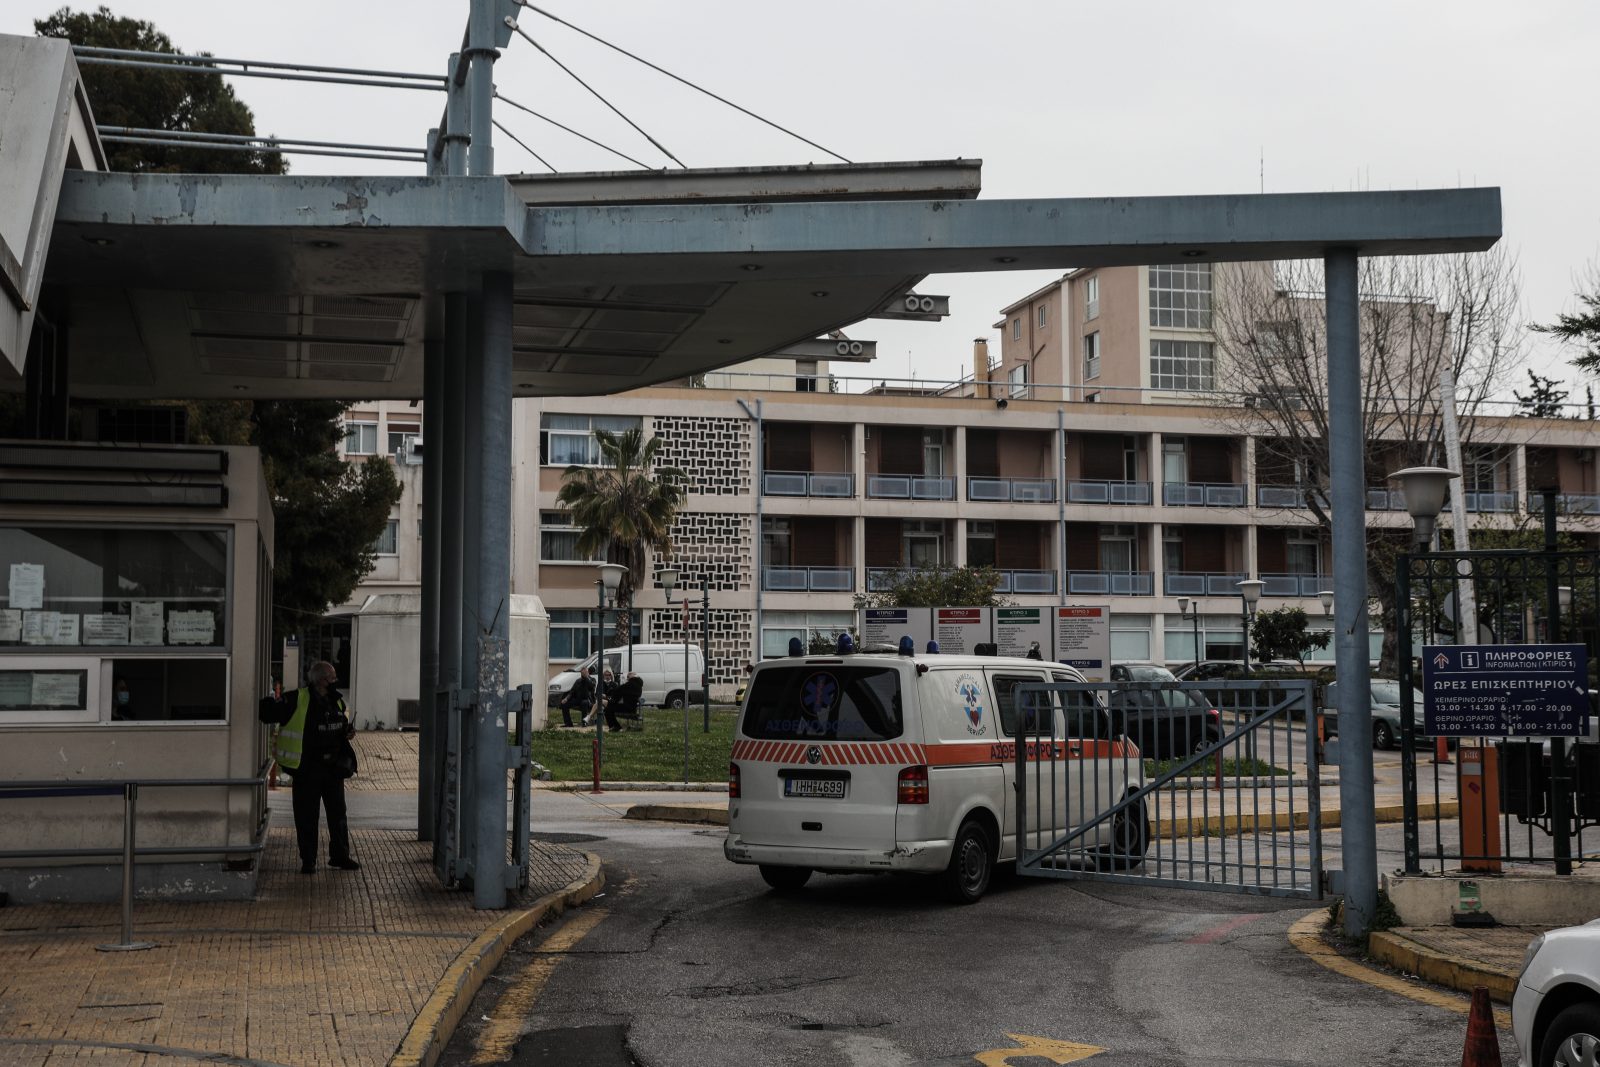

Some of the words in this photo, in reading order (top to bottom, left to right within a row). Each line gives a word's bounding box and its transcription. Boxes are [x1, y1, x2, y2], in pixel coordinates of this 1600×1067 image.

[1485, 652, 1572, 660] ΠΛΗΡΟΦΟΡΙΕΣ
[1434, 681, 1467, 690] ΩΡΕΣ
[1472, 680, 1575, 690] ΕΠΙΣΚΕΠΤΗΡΙΟΥ
[818, 782, 842, 793] 4699
